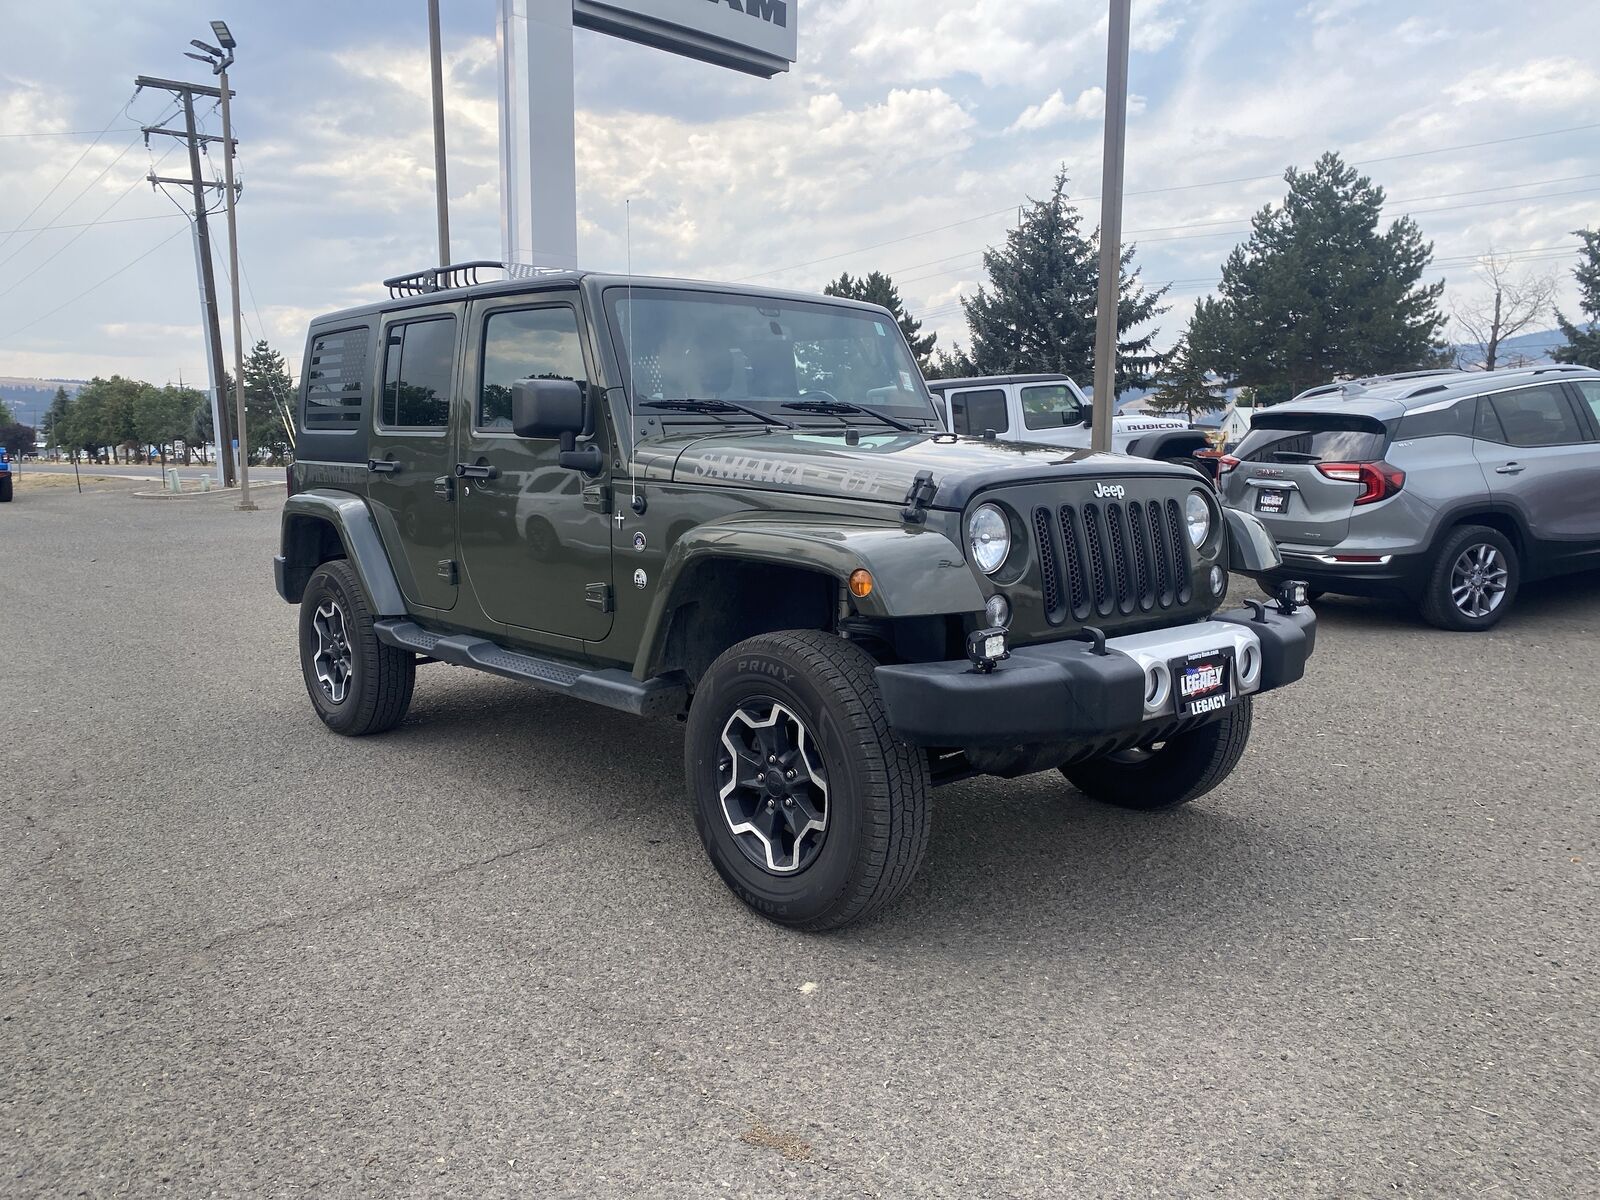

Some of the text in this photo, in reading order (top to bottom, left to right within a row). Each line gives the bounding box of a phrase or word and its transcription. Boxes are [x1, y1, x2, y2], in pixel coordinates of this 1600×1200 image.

[1127, 423, 1184, 431] RUBICON
[1094, 482, 1125, 500] Jeep
[737, 660, 796, 684] PRINX
[1180, 665, 1224, 697] LEGACY
[1191, 694, 1226, 715] LEGACY
